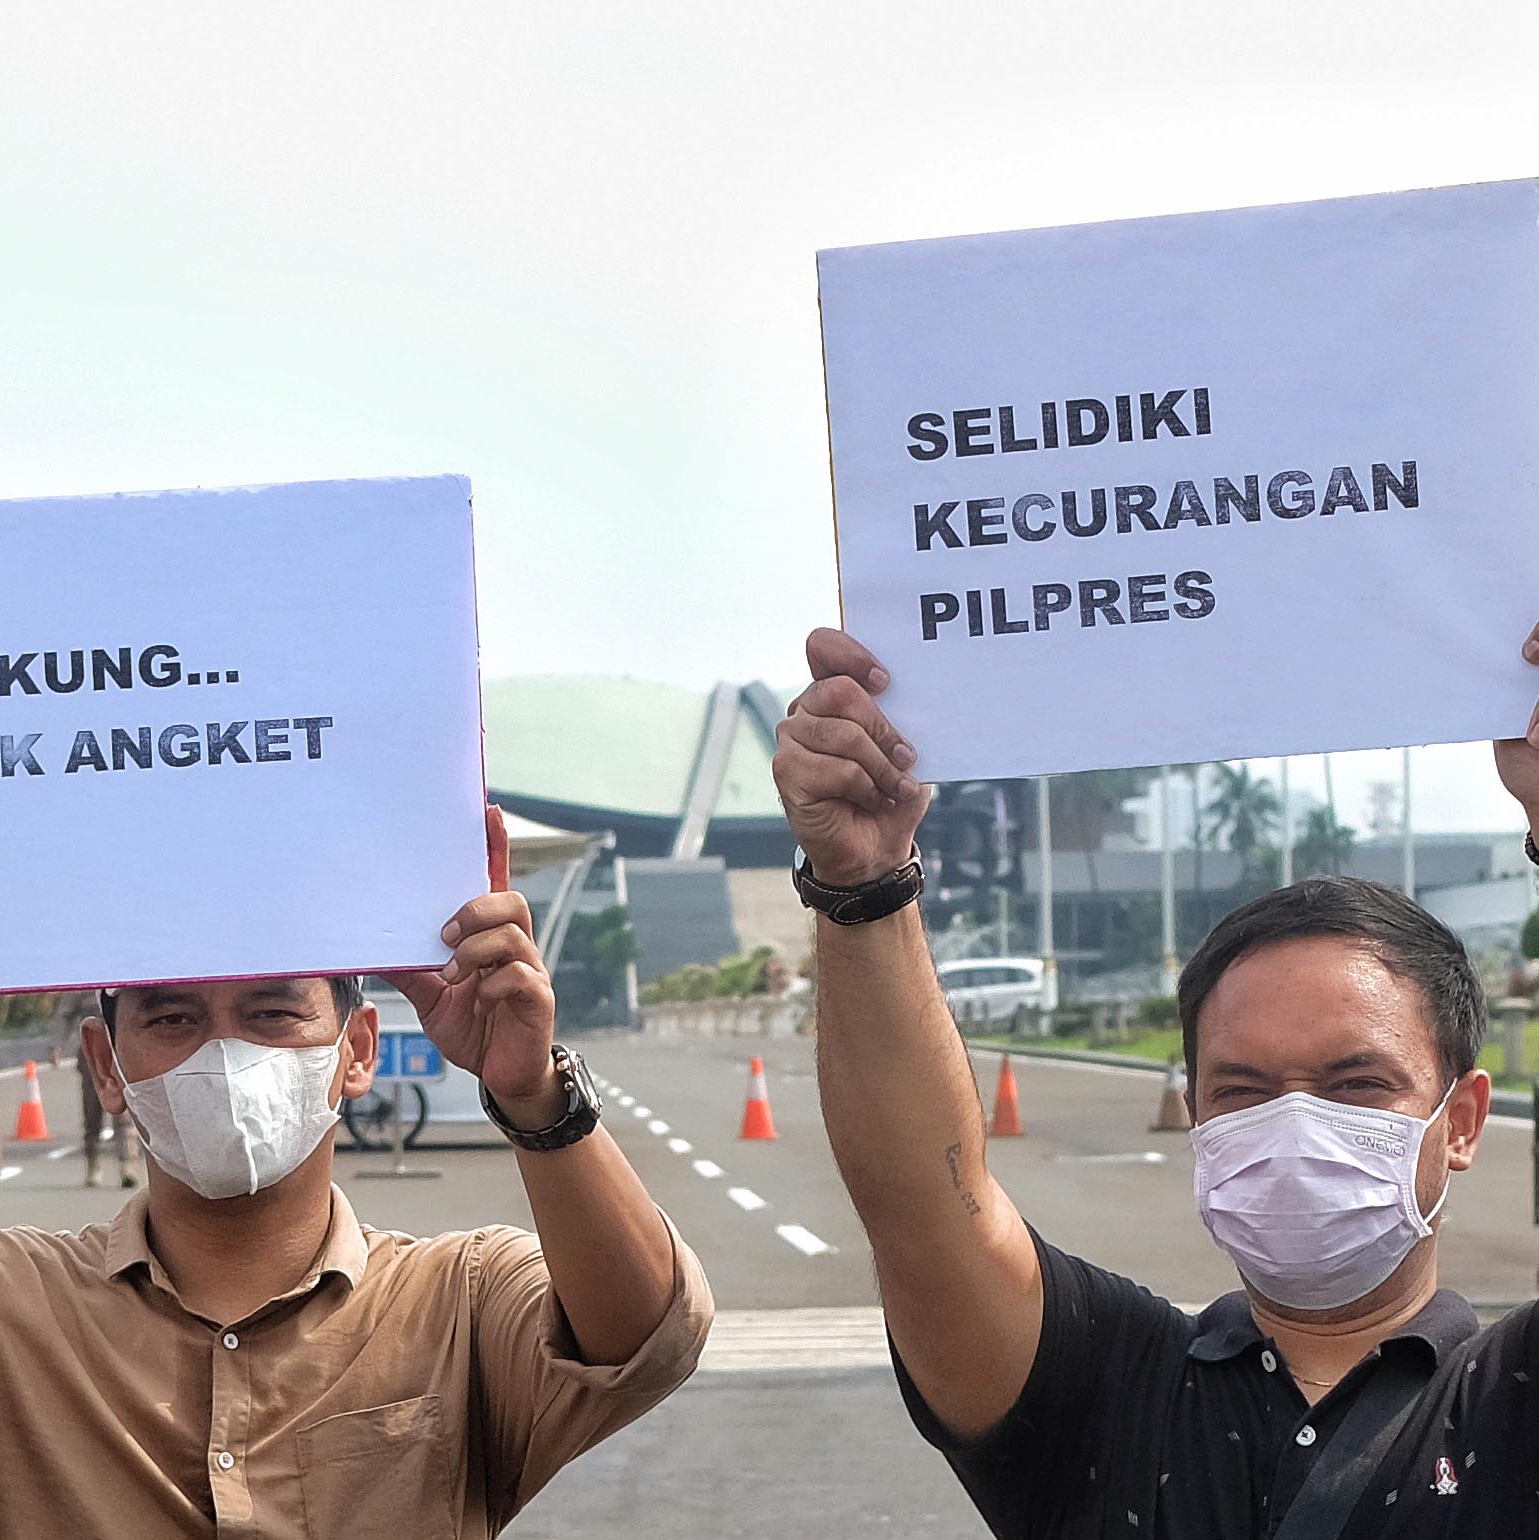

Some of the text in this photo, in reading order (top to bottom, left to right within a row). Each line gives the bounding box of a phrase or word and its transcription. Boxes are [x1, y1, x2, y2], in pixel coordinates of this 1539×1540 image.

[907, 388, 1211, 460] SELIDIKI
[914, 461, 1419, 551] KECURANGAN
[920, 571, 1215, 640] PILPRES
[65, 717, 333, 773] ANGKET
